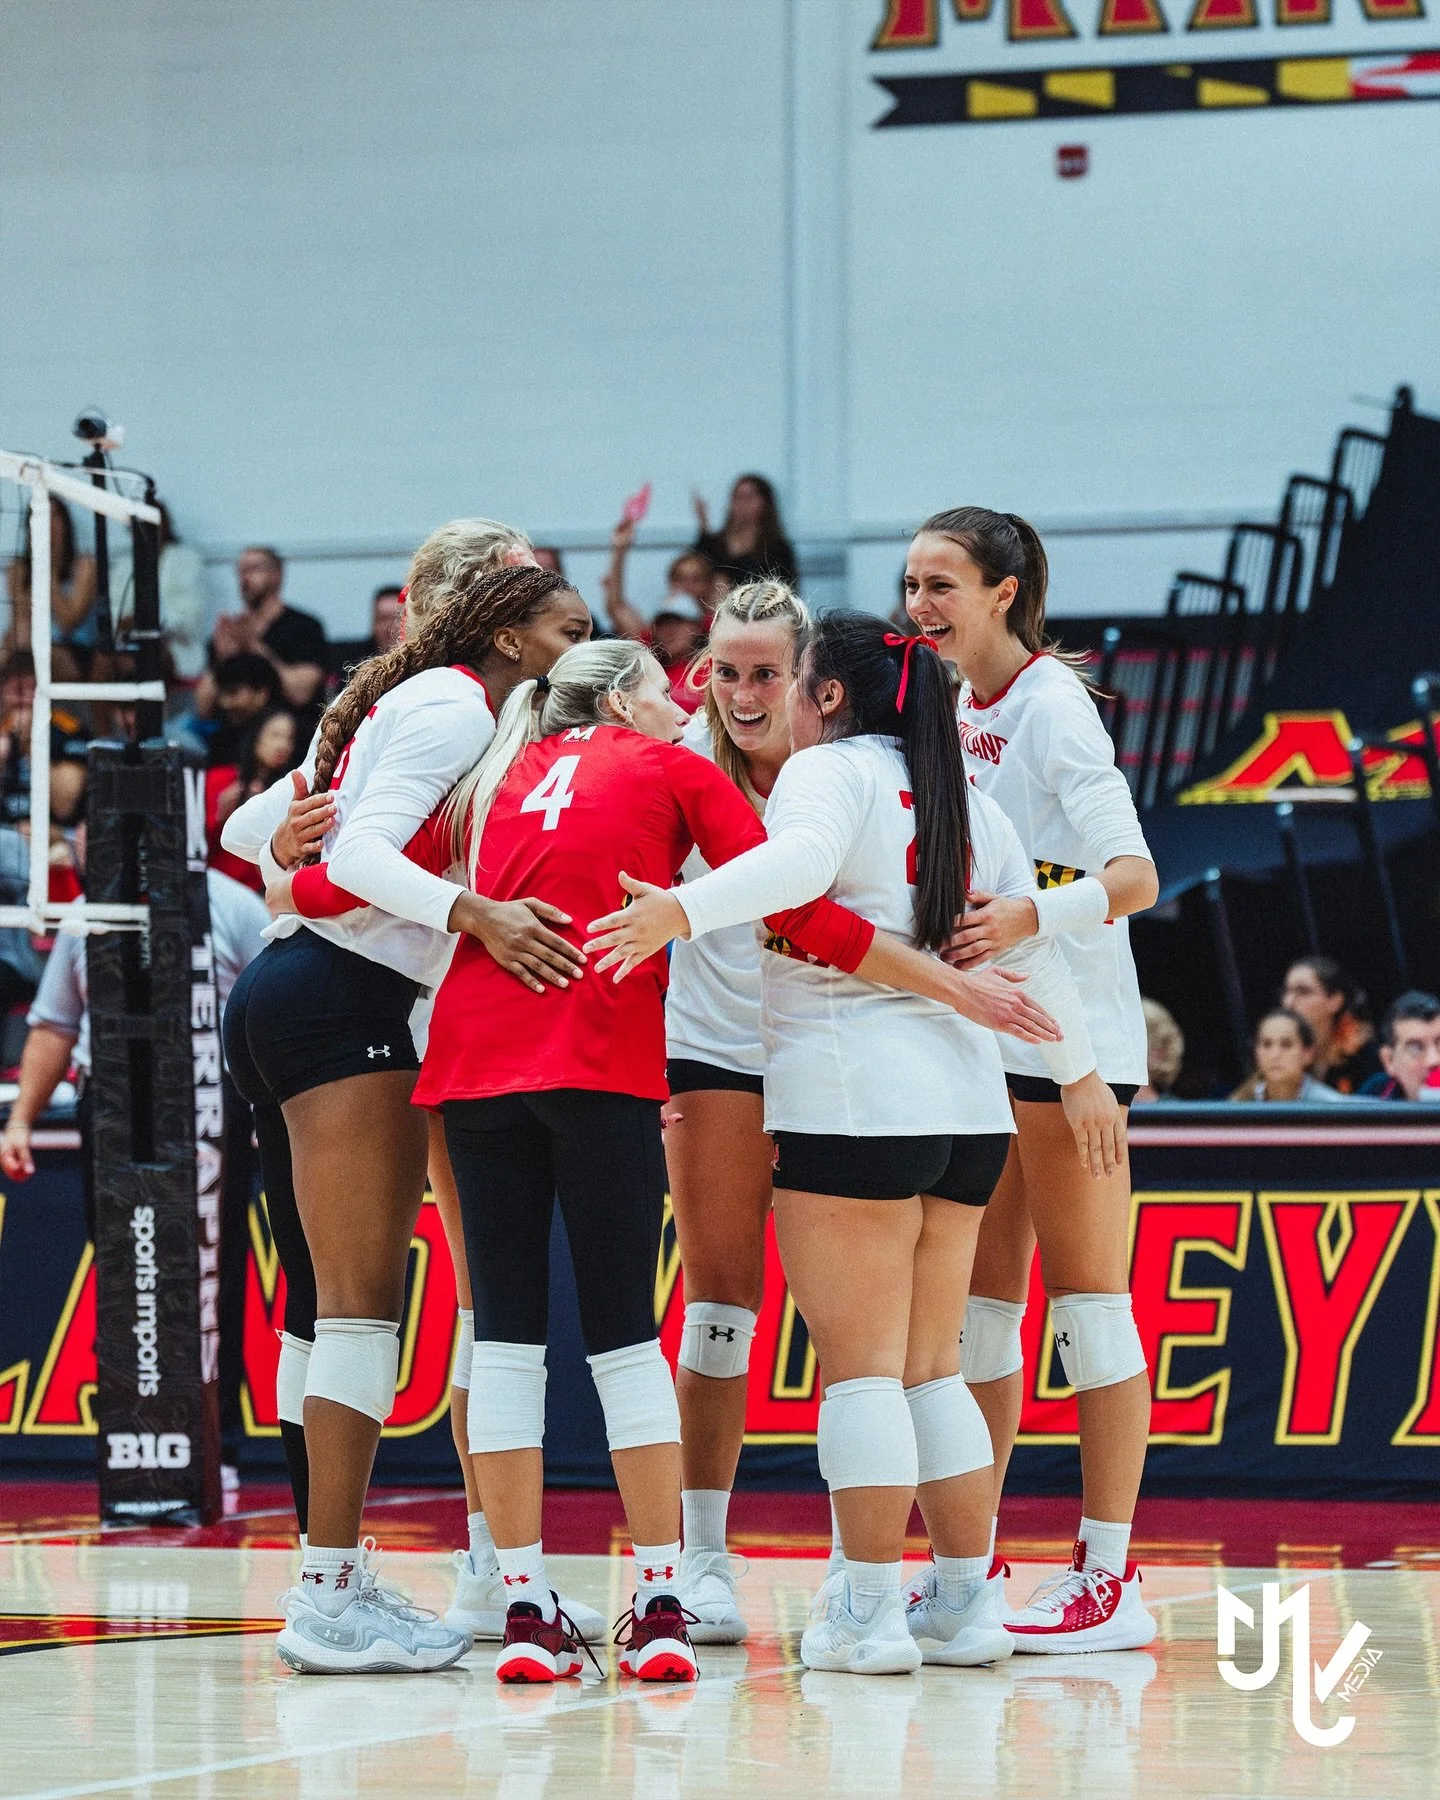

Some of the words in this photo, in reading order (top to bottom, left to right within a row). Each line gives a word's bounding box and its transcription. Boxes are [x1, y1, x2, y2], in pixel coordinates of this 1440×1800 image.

[520, 755, 582, 831] 4
[190, 933, 224, 1385] TERRAPINS
[128, 1205, 159, 1291] sports
[131, 1292, 161, 1397] imports
